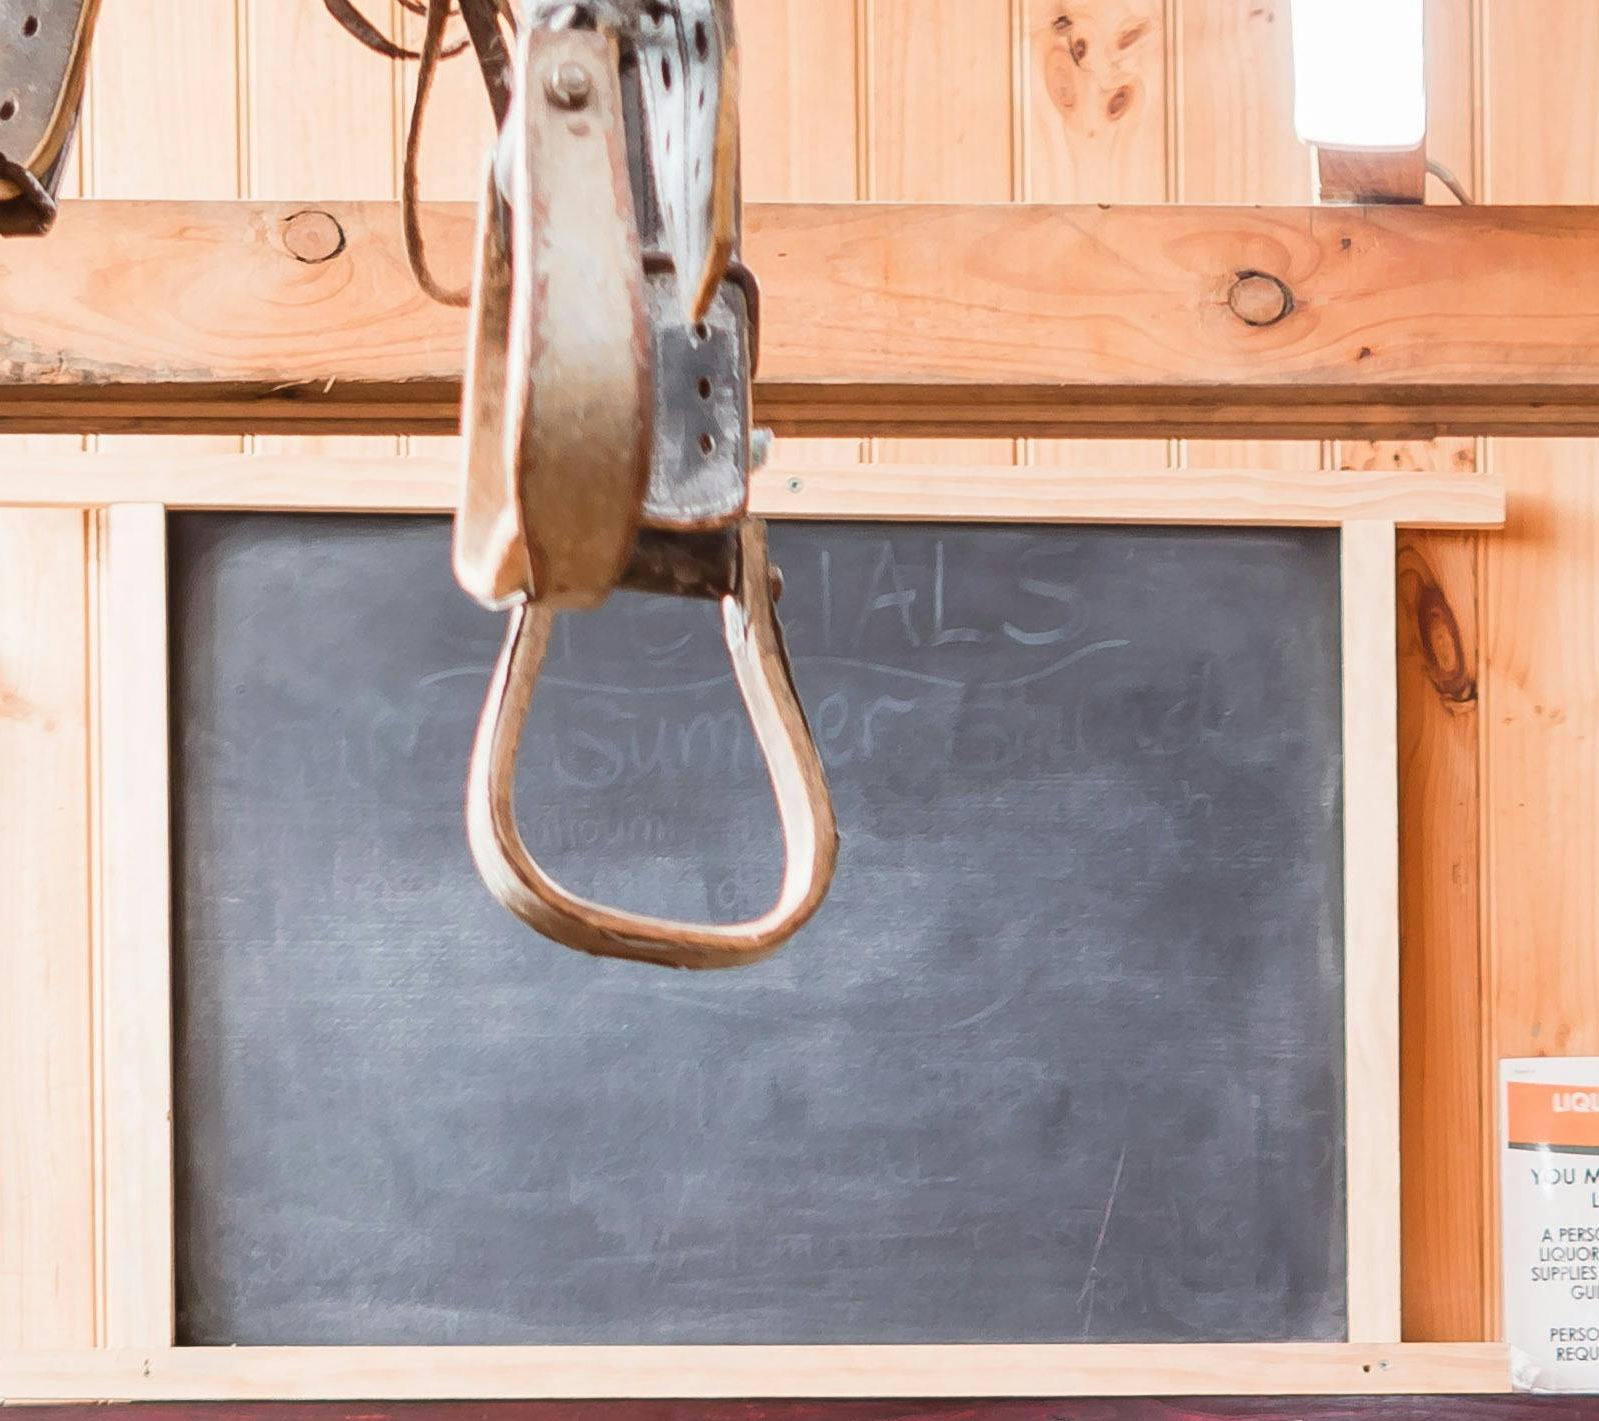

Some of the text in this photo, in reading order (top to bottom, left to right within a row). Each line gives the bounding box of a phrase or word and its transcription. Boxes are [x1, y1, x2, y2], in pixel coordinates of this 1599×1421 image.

[1531, 1170, 1575, 1184] YOU
[1542, 1229, 1552, 1242] A
[1540, 1247, 1598, 1261] LIQUOR
[1532, 1266, 1597, 1281] SUPPLIES
